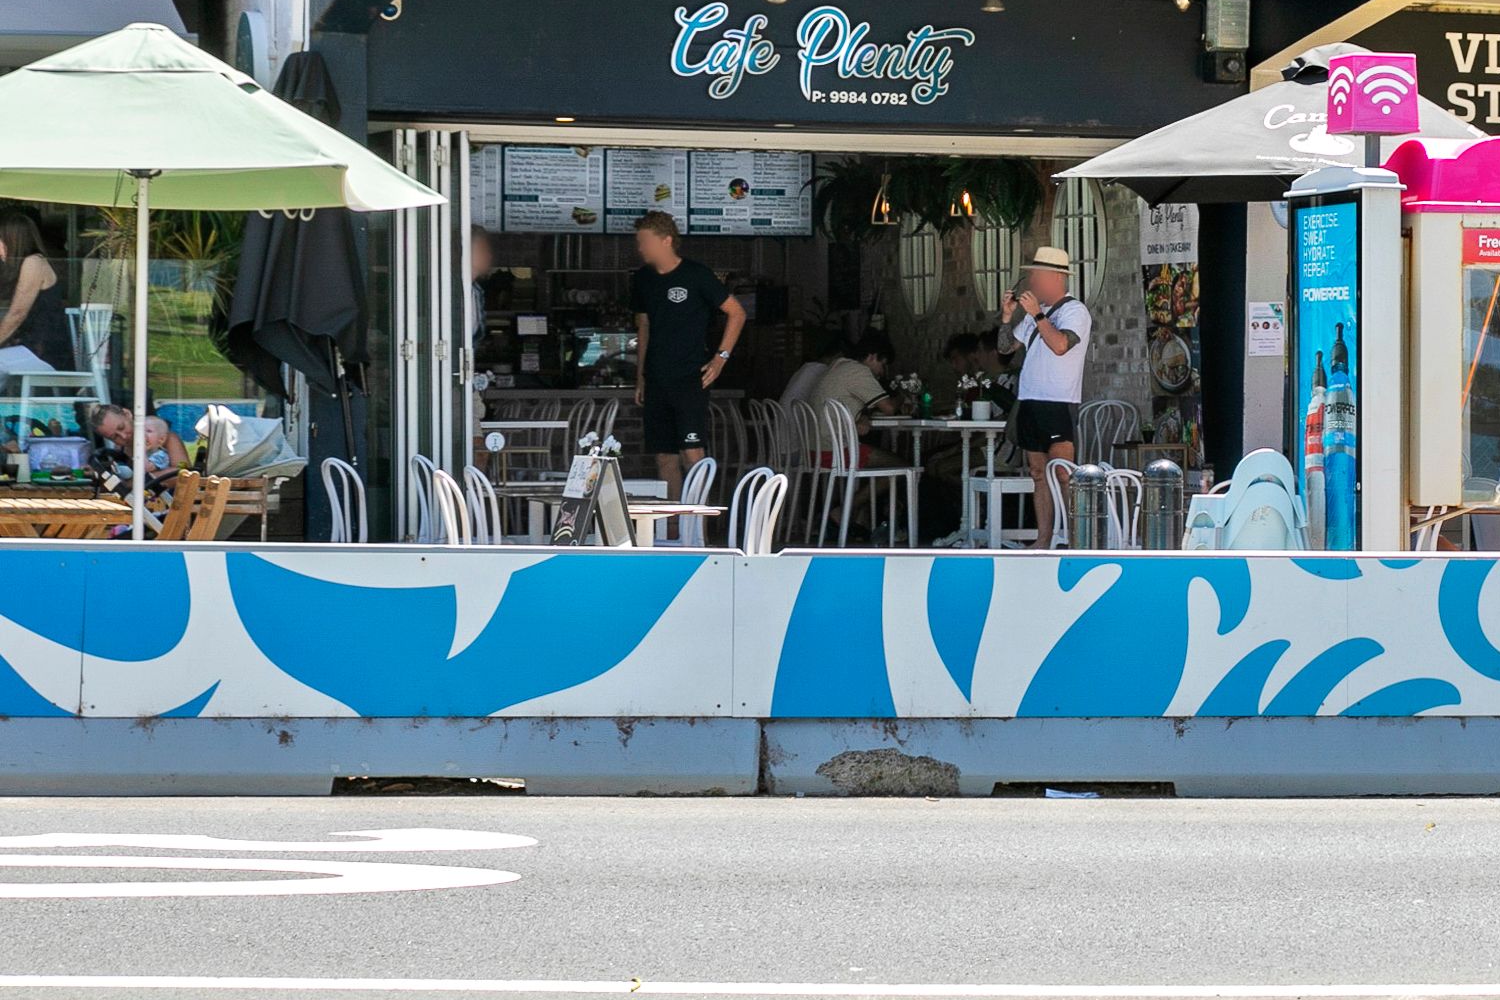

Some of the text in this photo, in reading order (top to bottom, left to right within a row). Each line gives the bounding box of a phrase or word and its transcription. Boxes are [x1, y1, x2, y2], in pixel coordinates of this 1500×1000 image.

[670, 2, 975, 105] Cafe Plenty
[811, 91, 908, 105] P: 9984 0782
[1302, 285, 1350, 302] POWERADE
